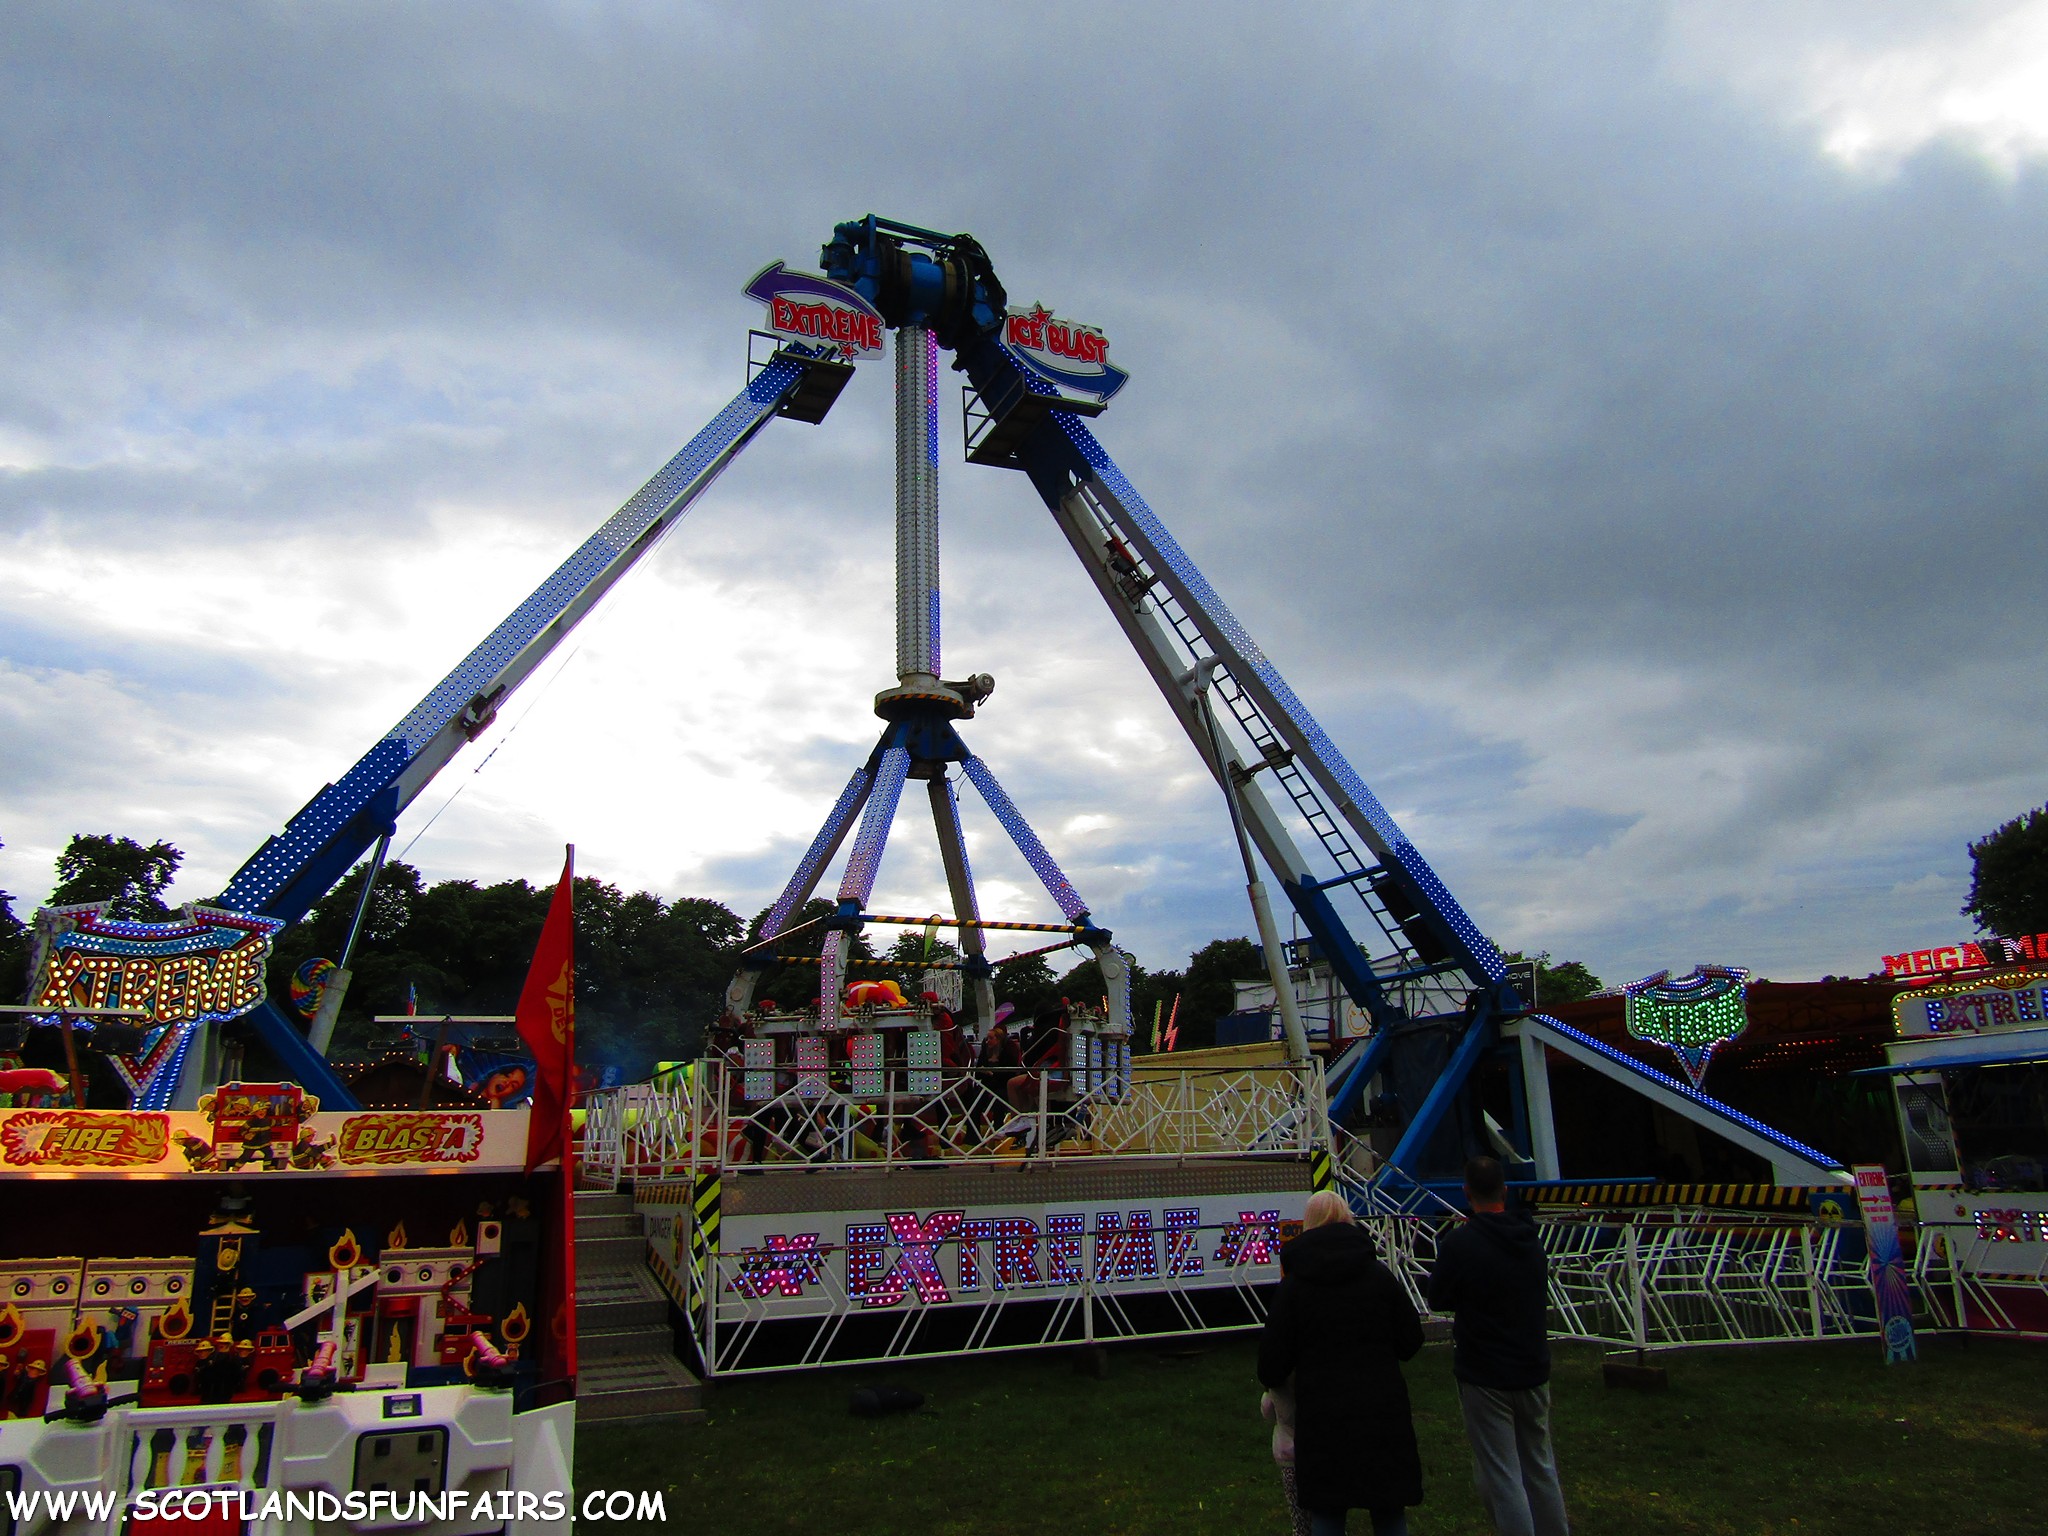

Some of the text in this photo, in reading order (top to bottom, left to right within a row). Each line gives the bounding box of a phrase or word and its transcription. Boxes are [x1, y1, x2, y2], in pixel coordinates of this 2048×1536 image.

[771, 297, 883, 350] EXTREME
[1007, 315, 1109, 364] ICE BLAST
[1881, 942, 1991, 977] MEGA
[1632, 982, 1745, 1044] EXTREME
[1924, 985, 2048, 1033] EXTRE
[40, 1127, 467, 1151] FIRE BLASTA
[1857, 1171, 1886, 1187] EXTREME
[649, 1216, 673, 1240] DANGER
[845, 1208, 1204, 1309] EXTREME
